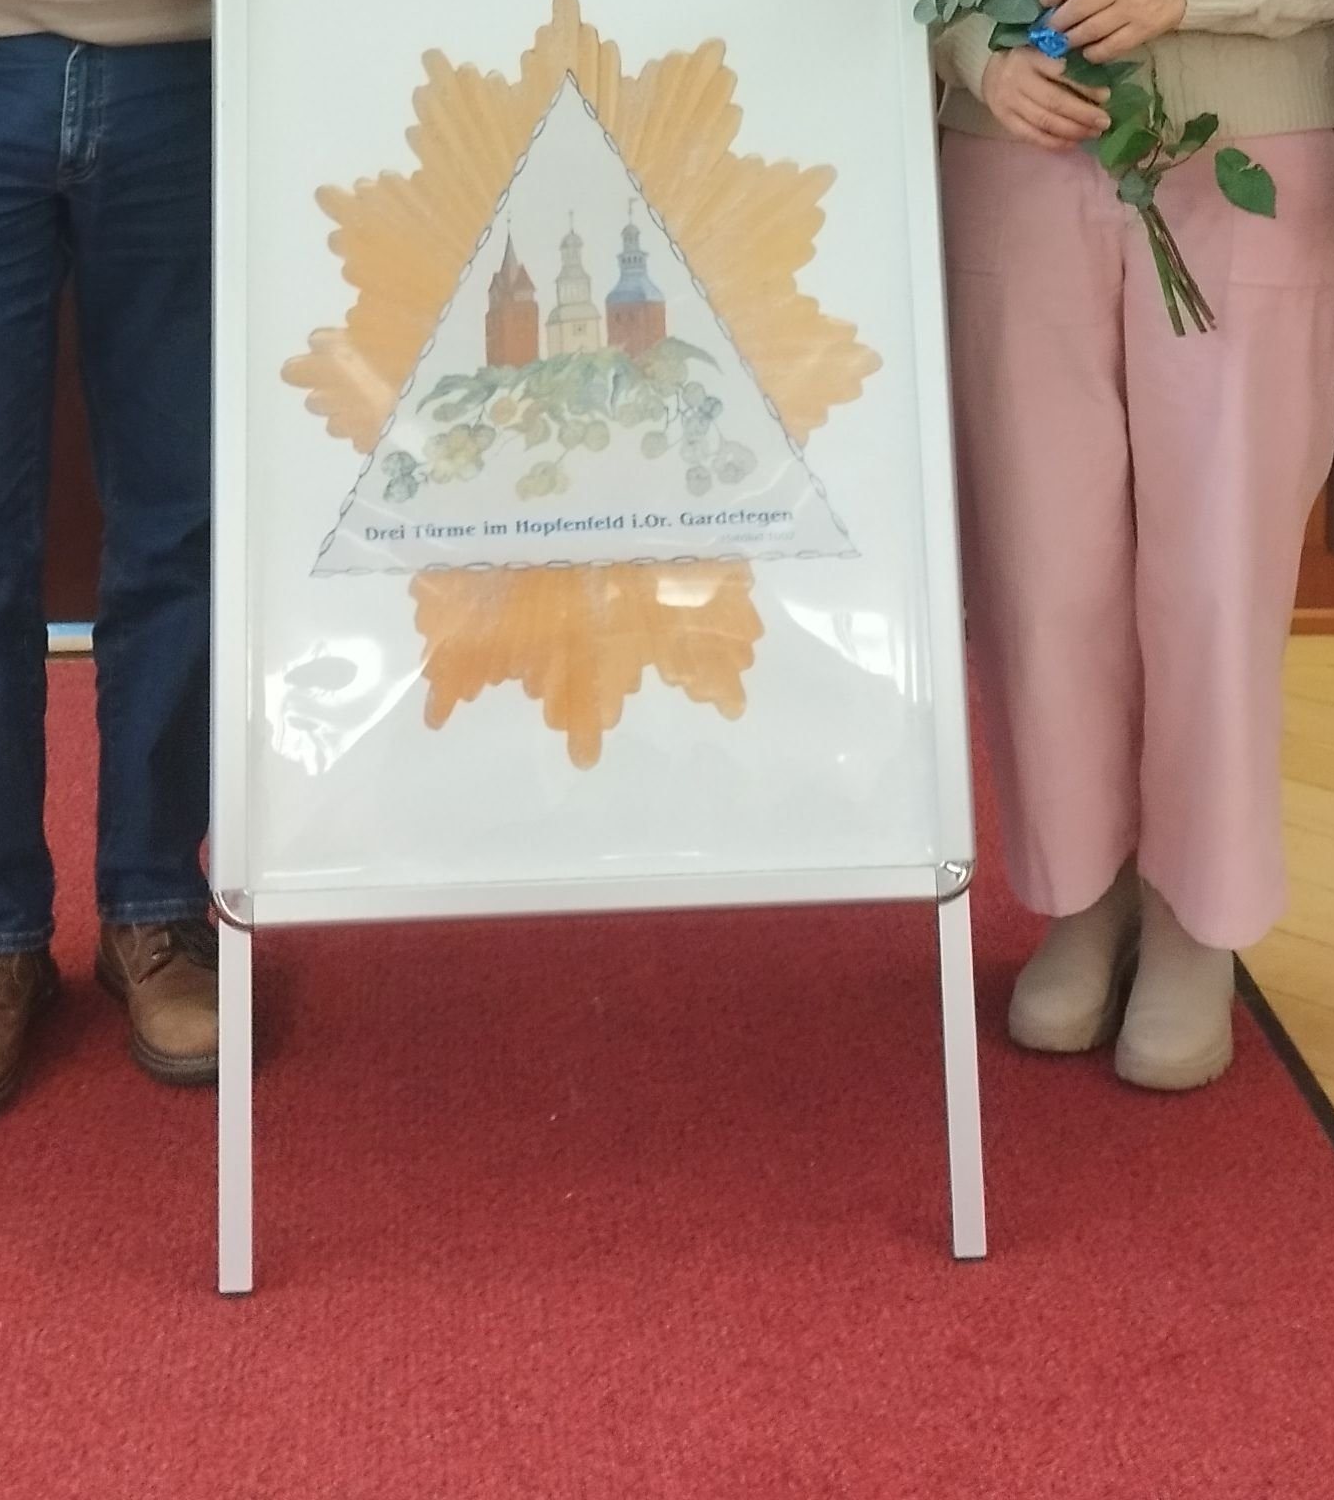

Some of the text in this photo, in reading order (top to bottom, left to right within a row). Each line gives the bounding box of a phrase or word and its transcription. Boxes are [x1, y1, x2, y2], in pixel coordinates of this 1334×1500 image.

[365, 524, 405, 542] Drei
[415, 522, 476, 539] Türme
[482, 520, 508, 536] im
[516, 514, 625, 537] Hopfenfeld
[679, 508, 793, 528] Gardelegen
